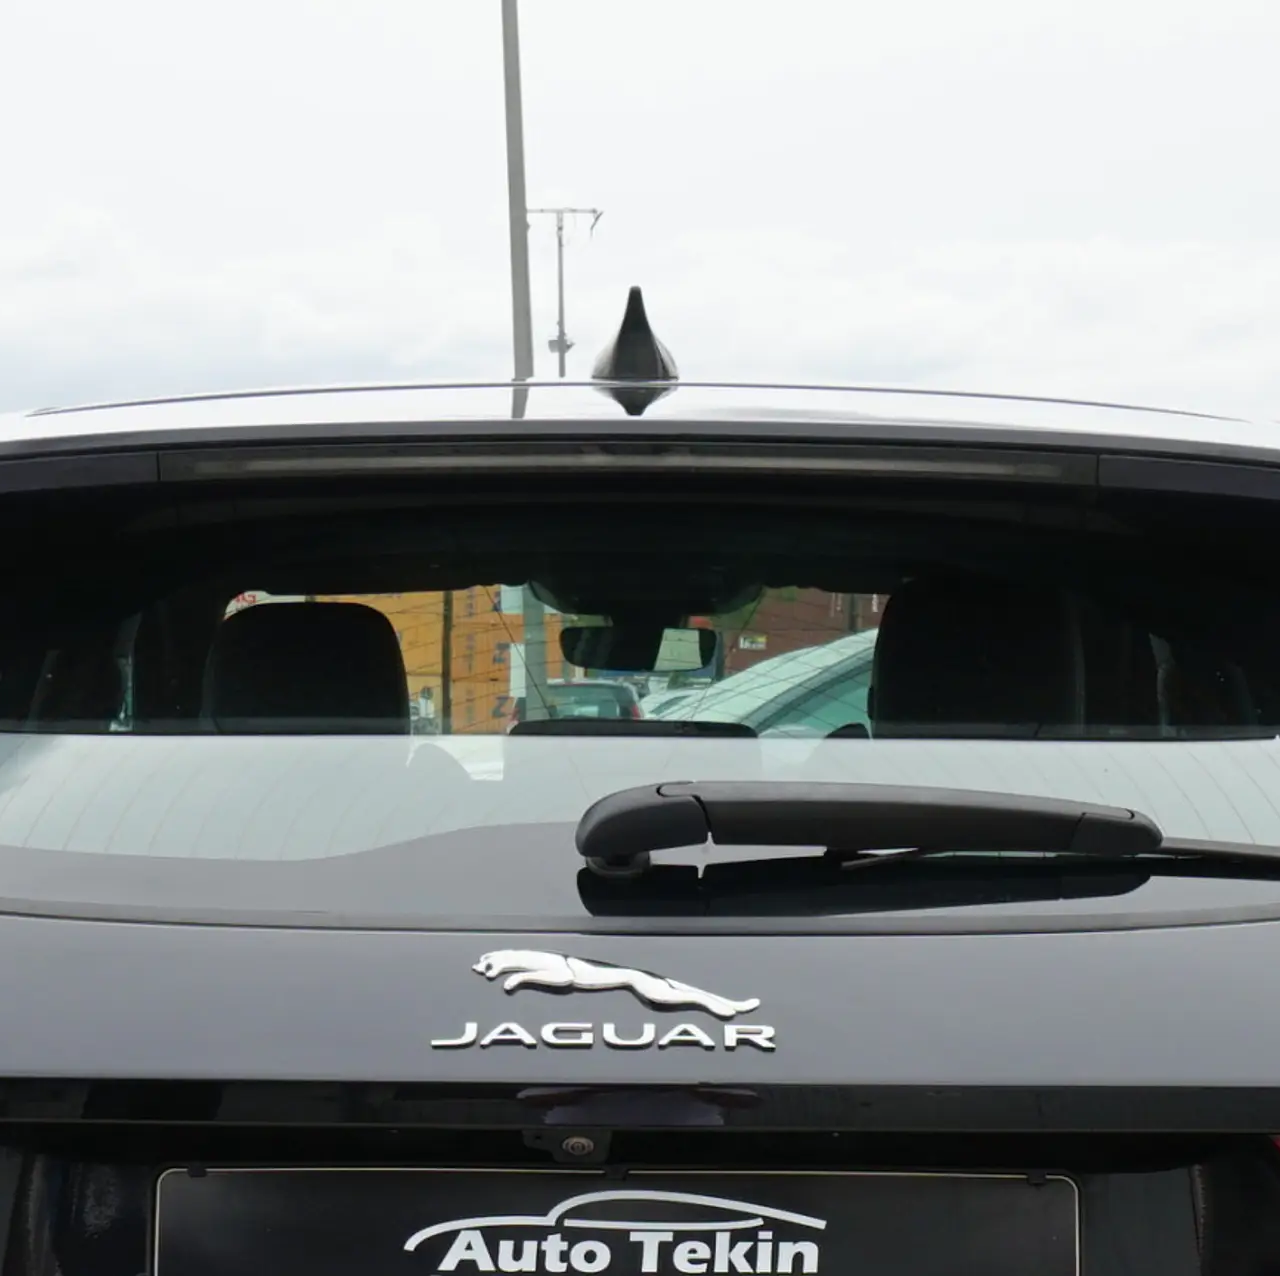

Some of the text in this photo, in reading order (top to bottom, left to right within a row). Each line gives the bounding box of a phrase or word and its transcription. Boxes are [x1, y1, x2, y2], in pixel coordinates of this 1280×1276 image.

[431, 1021, 777, 1051] JAGUAR
[437, 1230, 819, 1274] Auto Tekin
